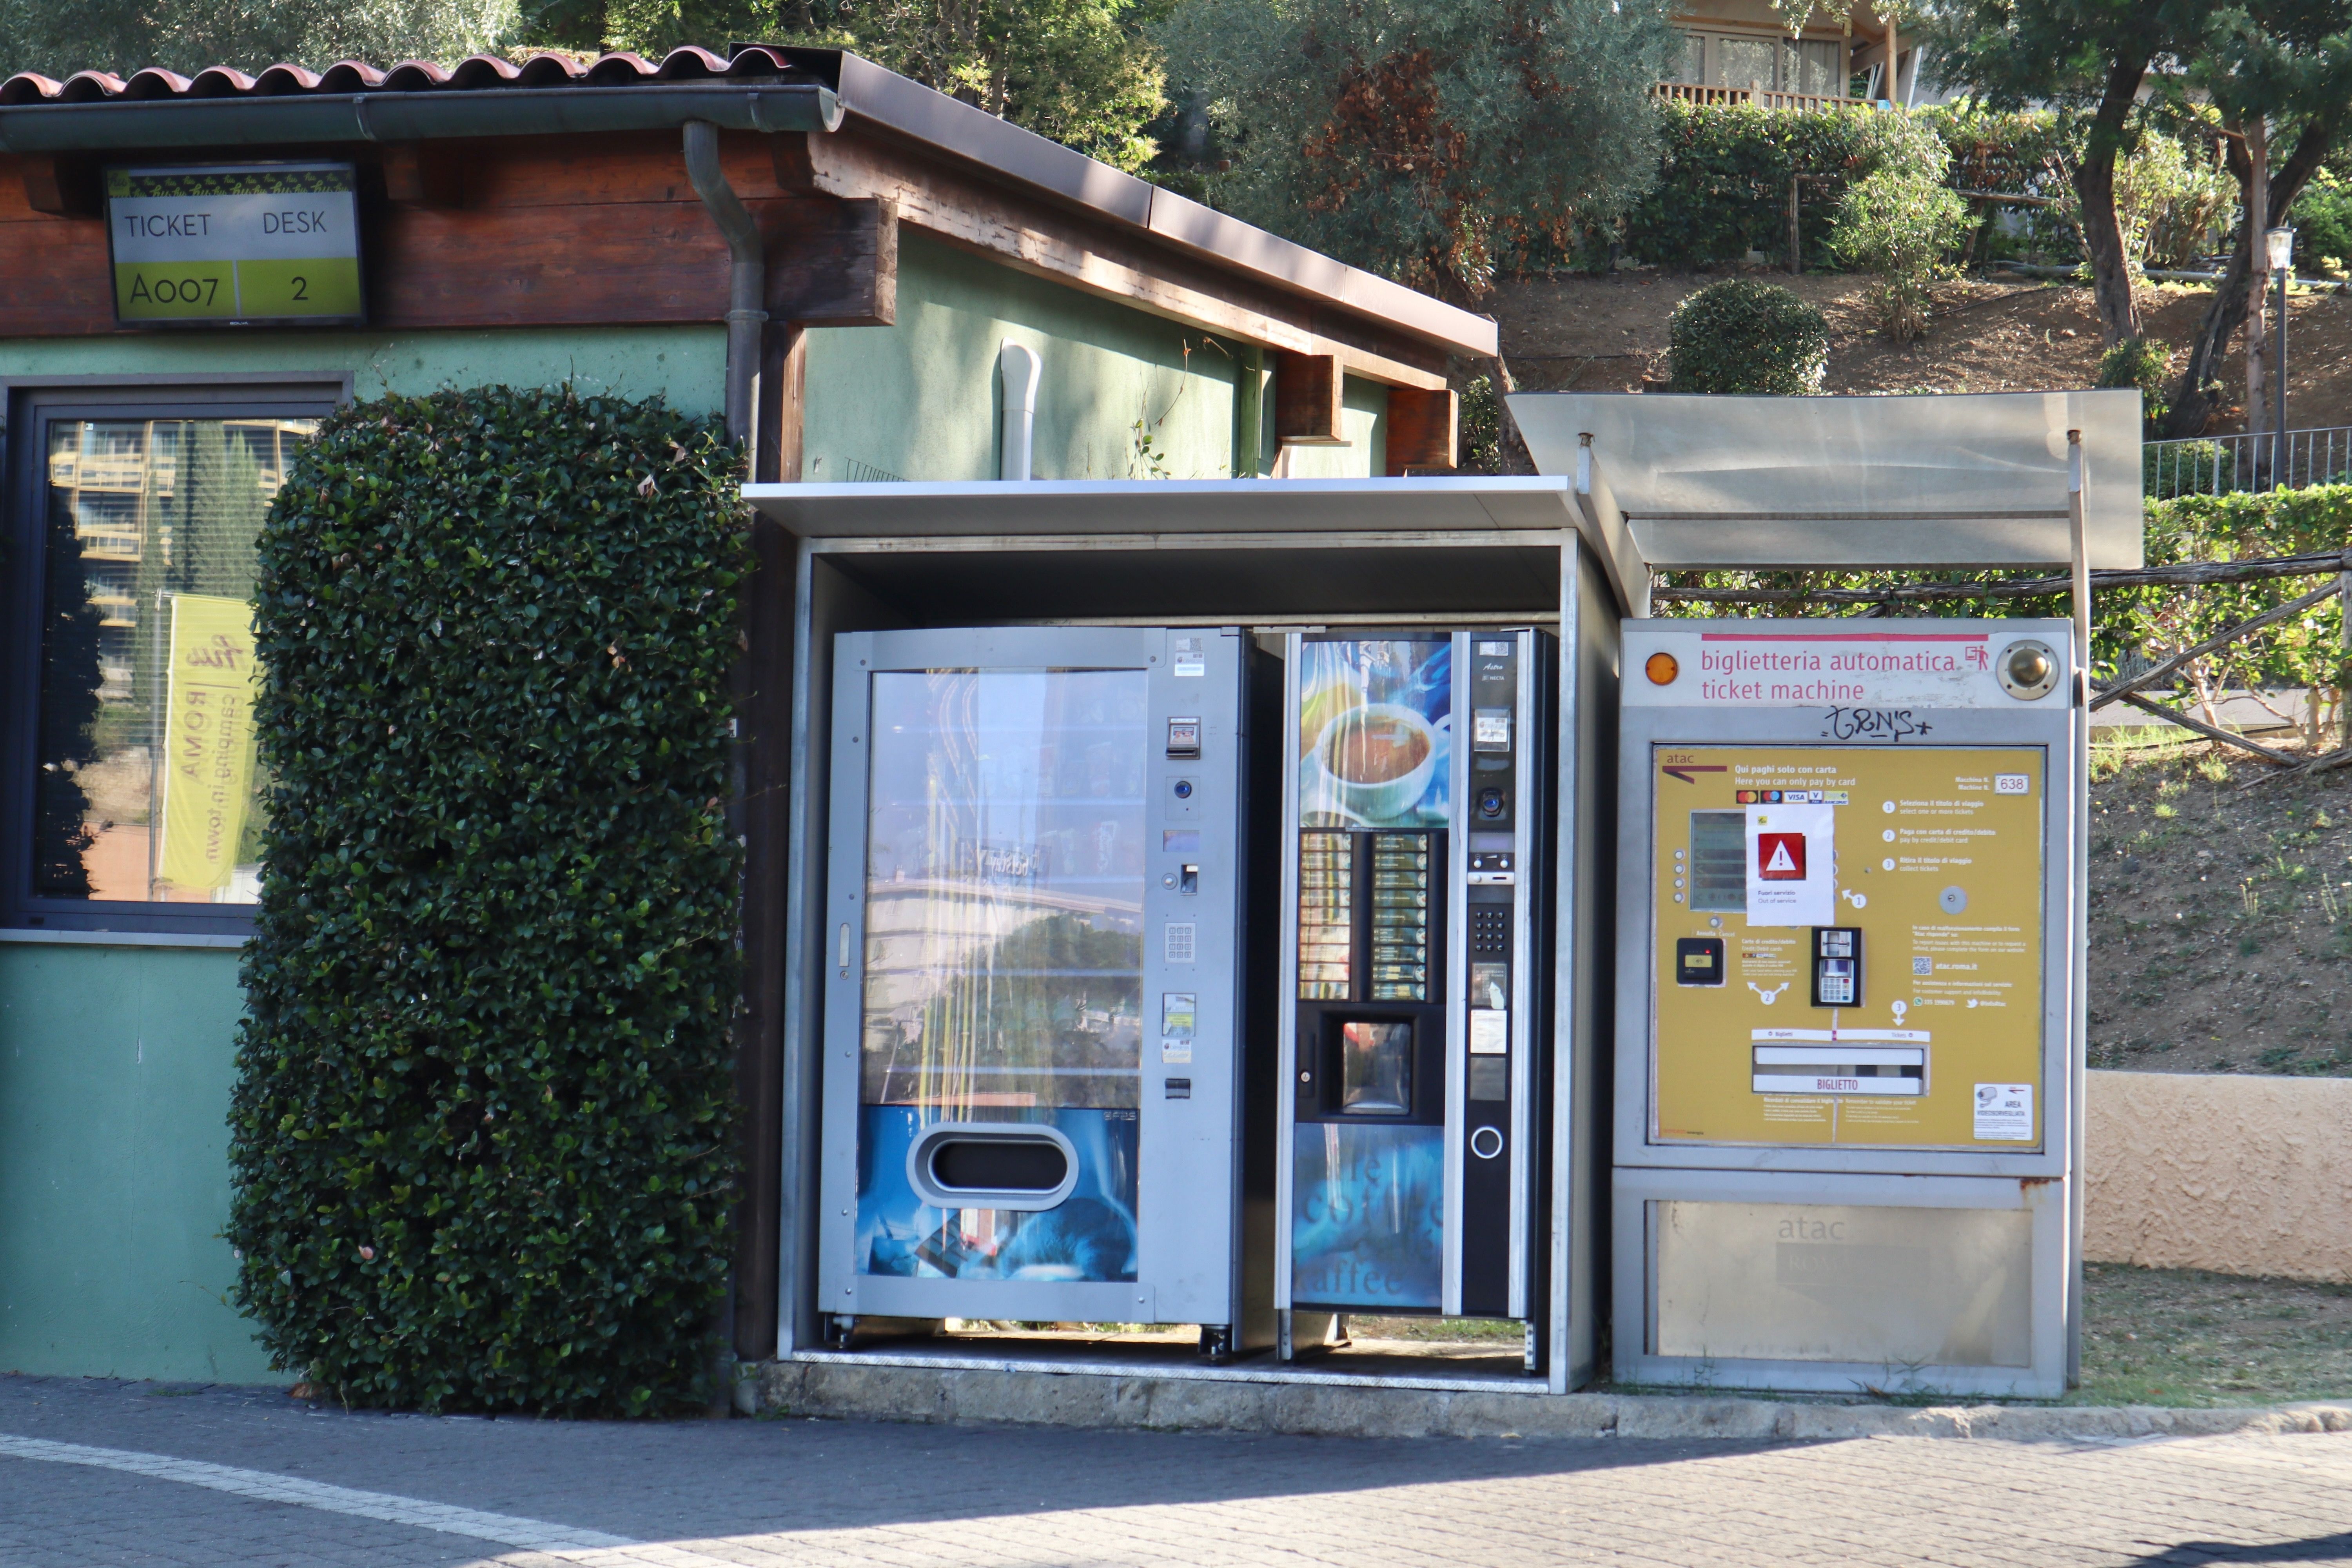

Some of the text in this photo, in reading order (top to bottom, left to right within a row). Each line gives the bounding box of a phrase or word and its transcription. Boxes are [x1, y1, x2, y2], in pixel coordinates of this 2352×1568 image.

[124, 211, 327, 237] TICKET DESK
[130, 272, 308, 307] A007 2
[1702, 650, 1955, 675] biglietteria automatica
[1702, 680, 1864, 700] ticket machine
[1666, 753, 1694, 764] atac
[1735, 765, 1749, 773] Qui
[1751, 765, 1775, 775] paghi
[1789, 778, 1807, 786] only
[1826, 777, 1836, 787] by
[2000, 779, 2024, 789] 638
[1817, 1079, 1858, 1090] BIGLIETTO
[1778, 1217, 1844, 1240] atac
